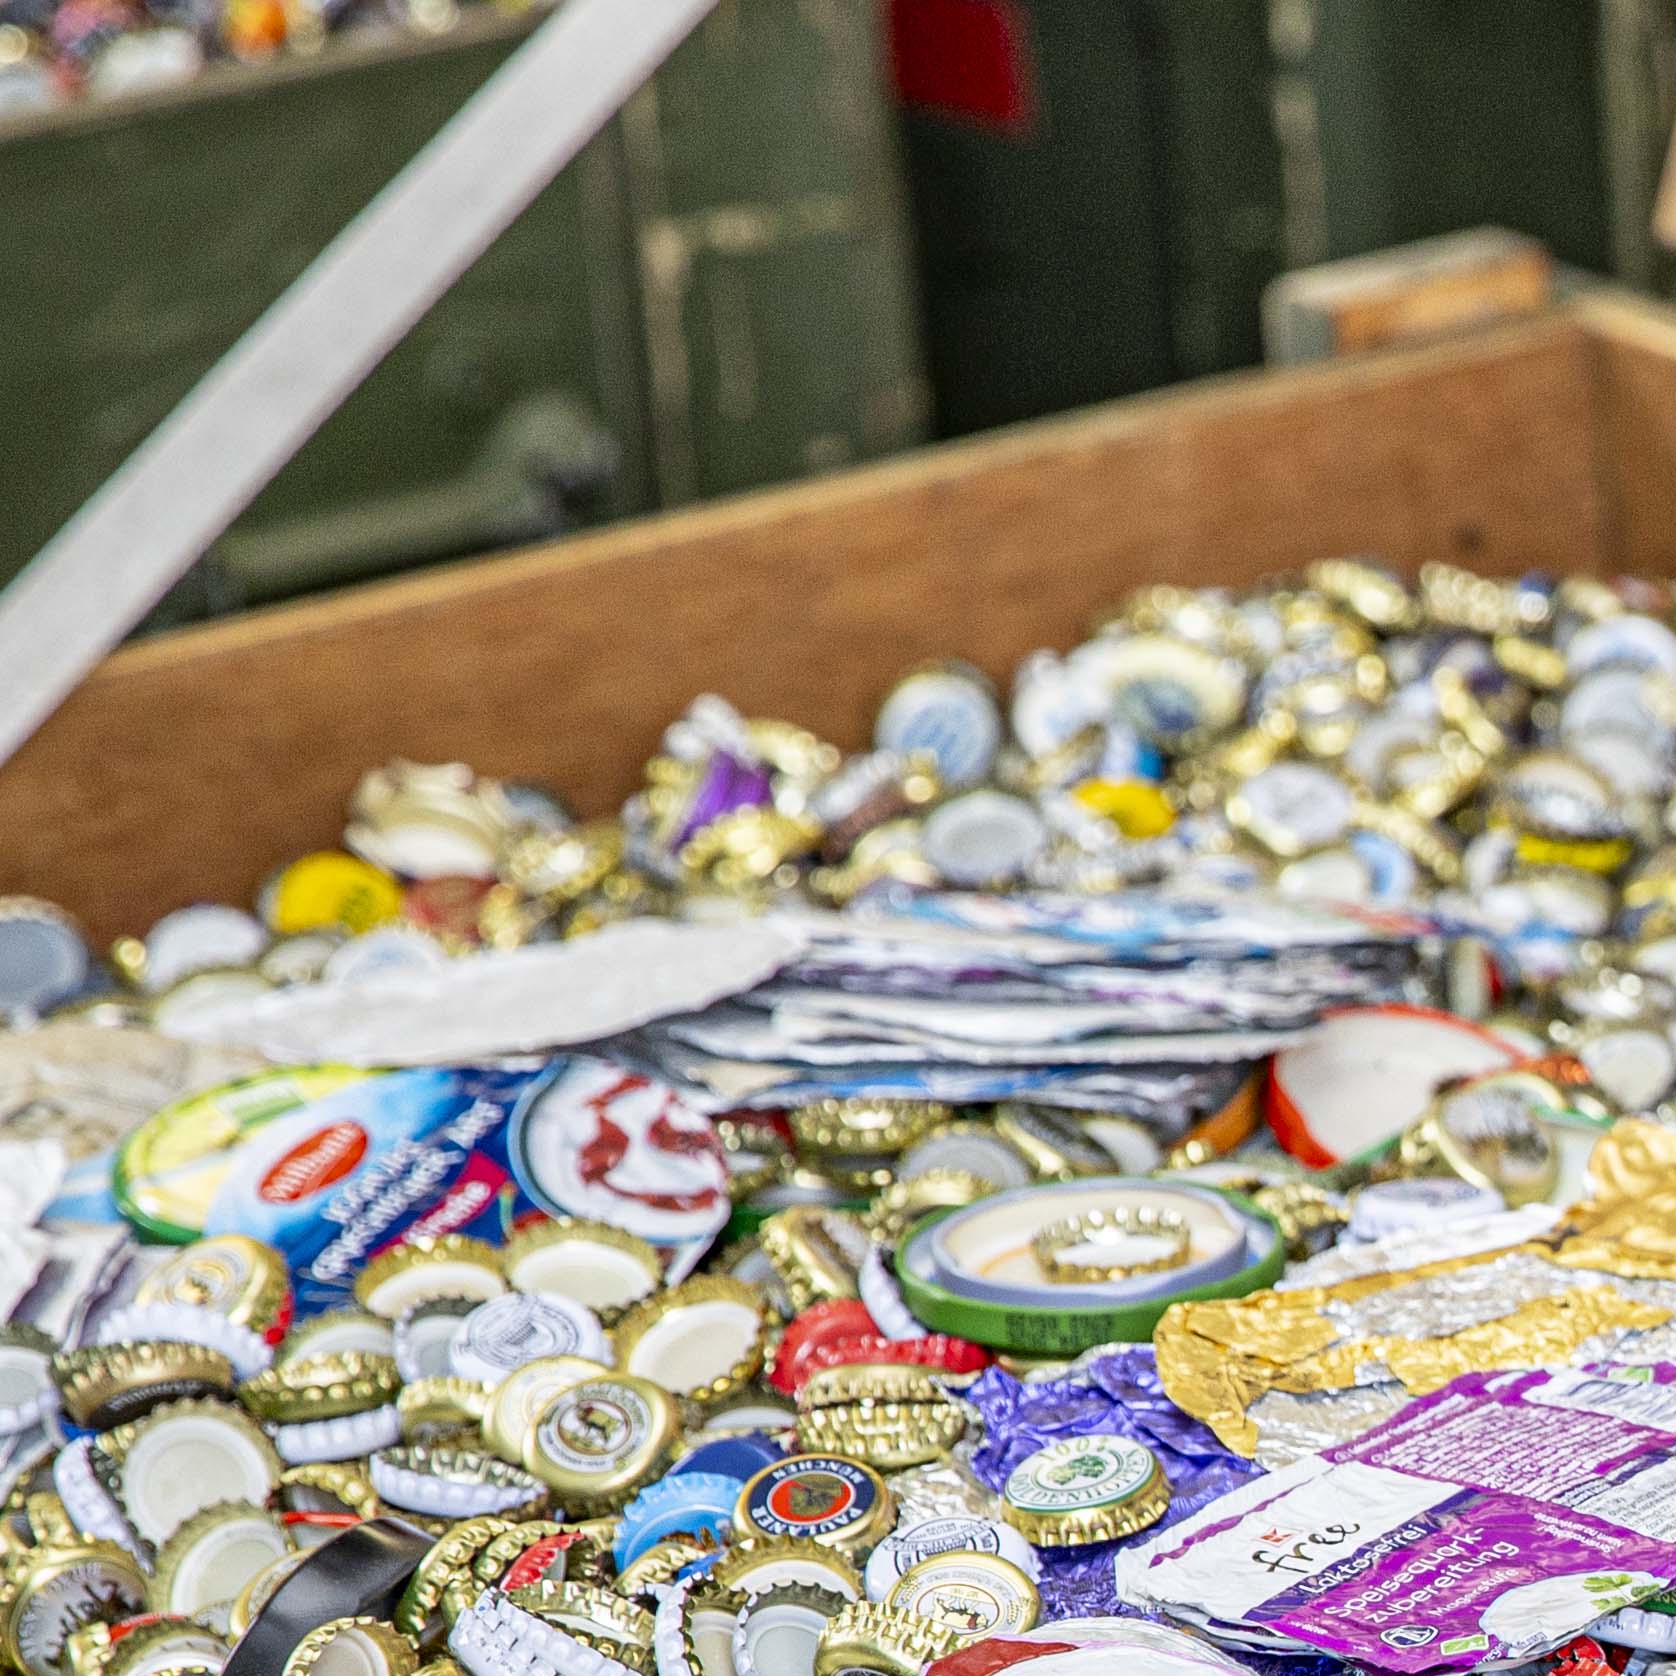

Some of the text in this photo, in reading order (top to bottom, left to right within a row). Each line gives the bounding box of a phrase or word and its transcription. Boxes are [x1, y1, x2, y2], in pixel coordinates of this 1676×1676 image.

[772, 1461, 867, 1485] MÜNCHEN
[751, 1503, 865, 1538] PAULANER
[1251, 1522, 1360, 1575] free
[1298, 1523, 1429, 1595] Laktosefrei
[1323, 1525, 1485, 1620] Speisequark-
[1364, 1538, 1520, 1624] zubereitung
[1428, 1566, 1520, 1618] Magerstufe
